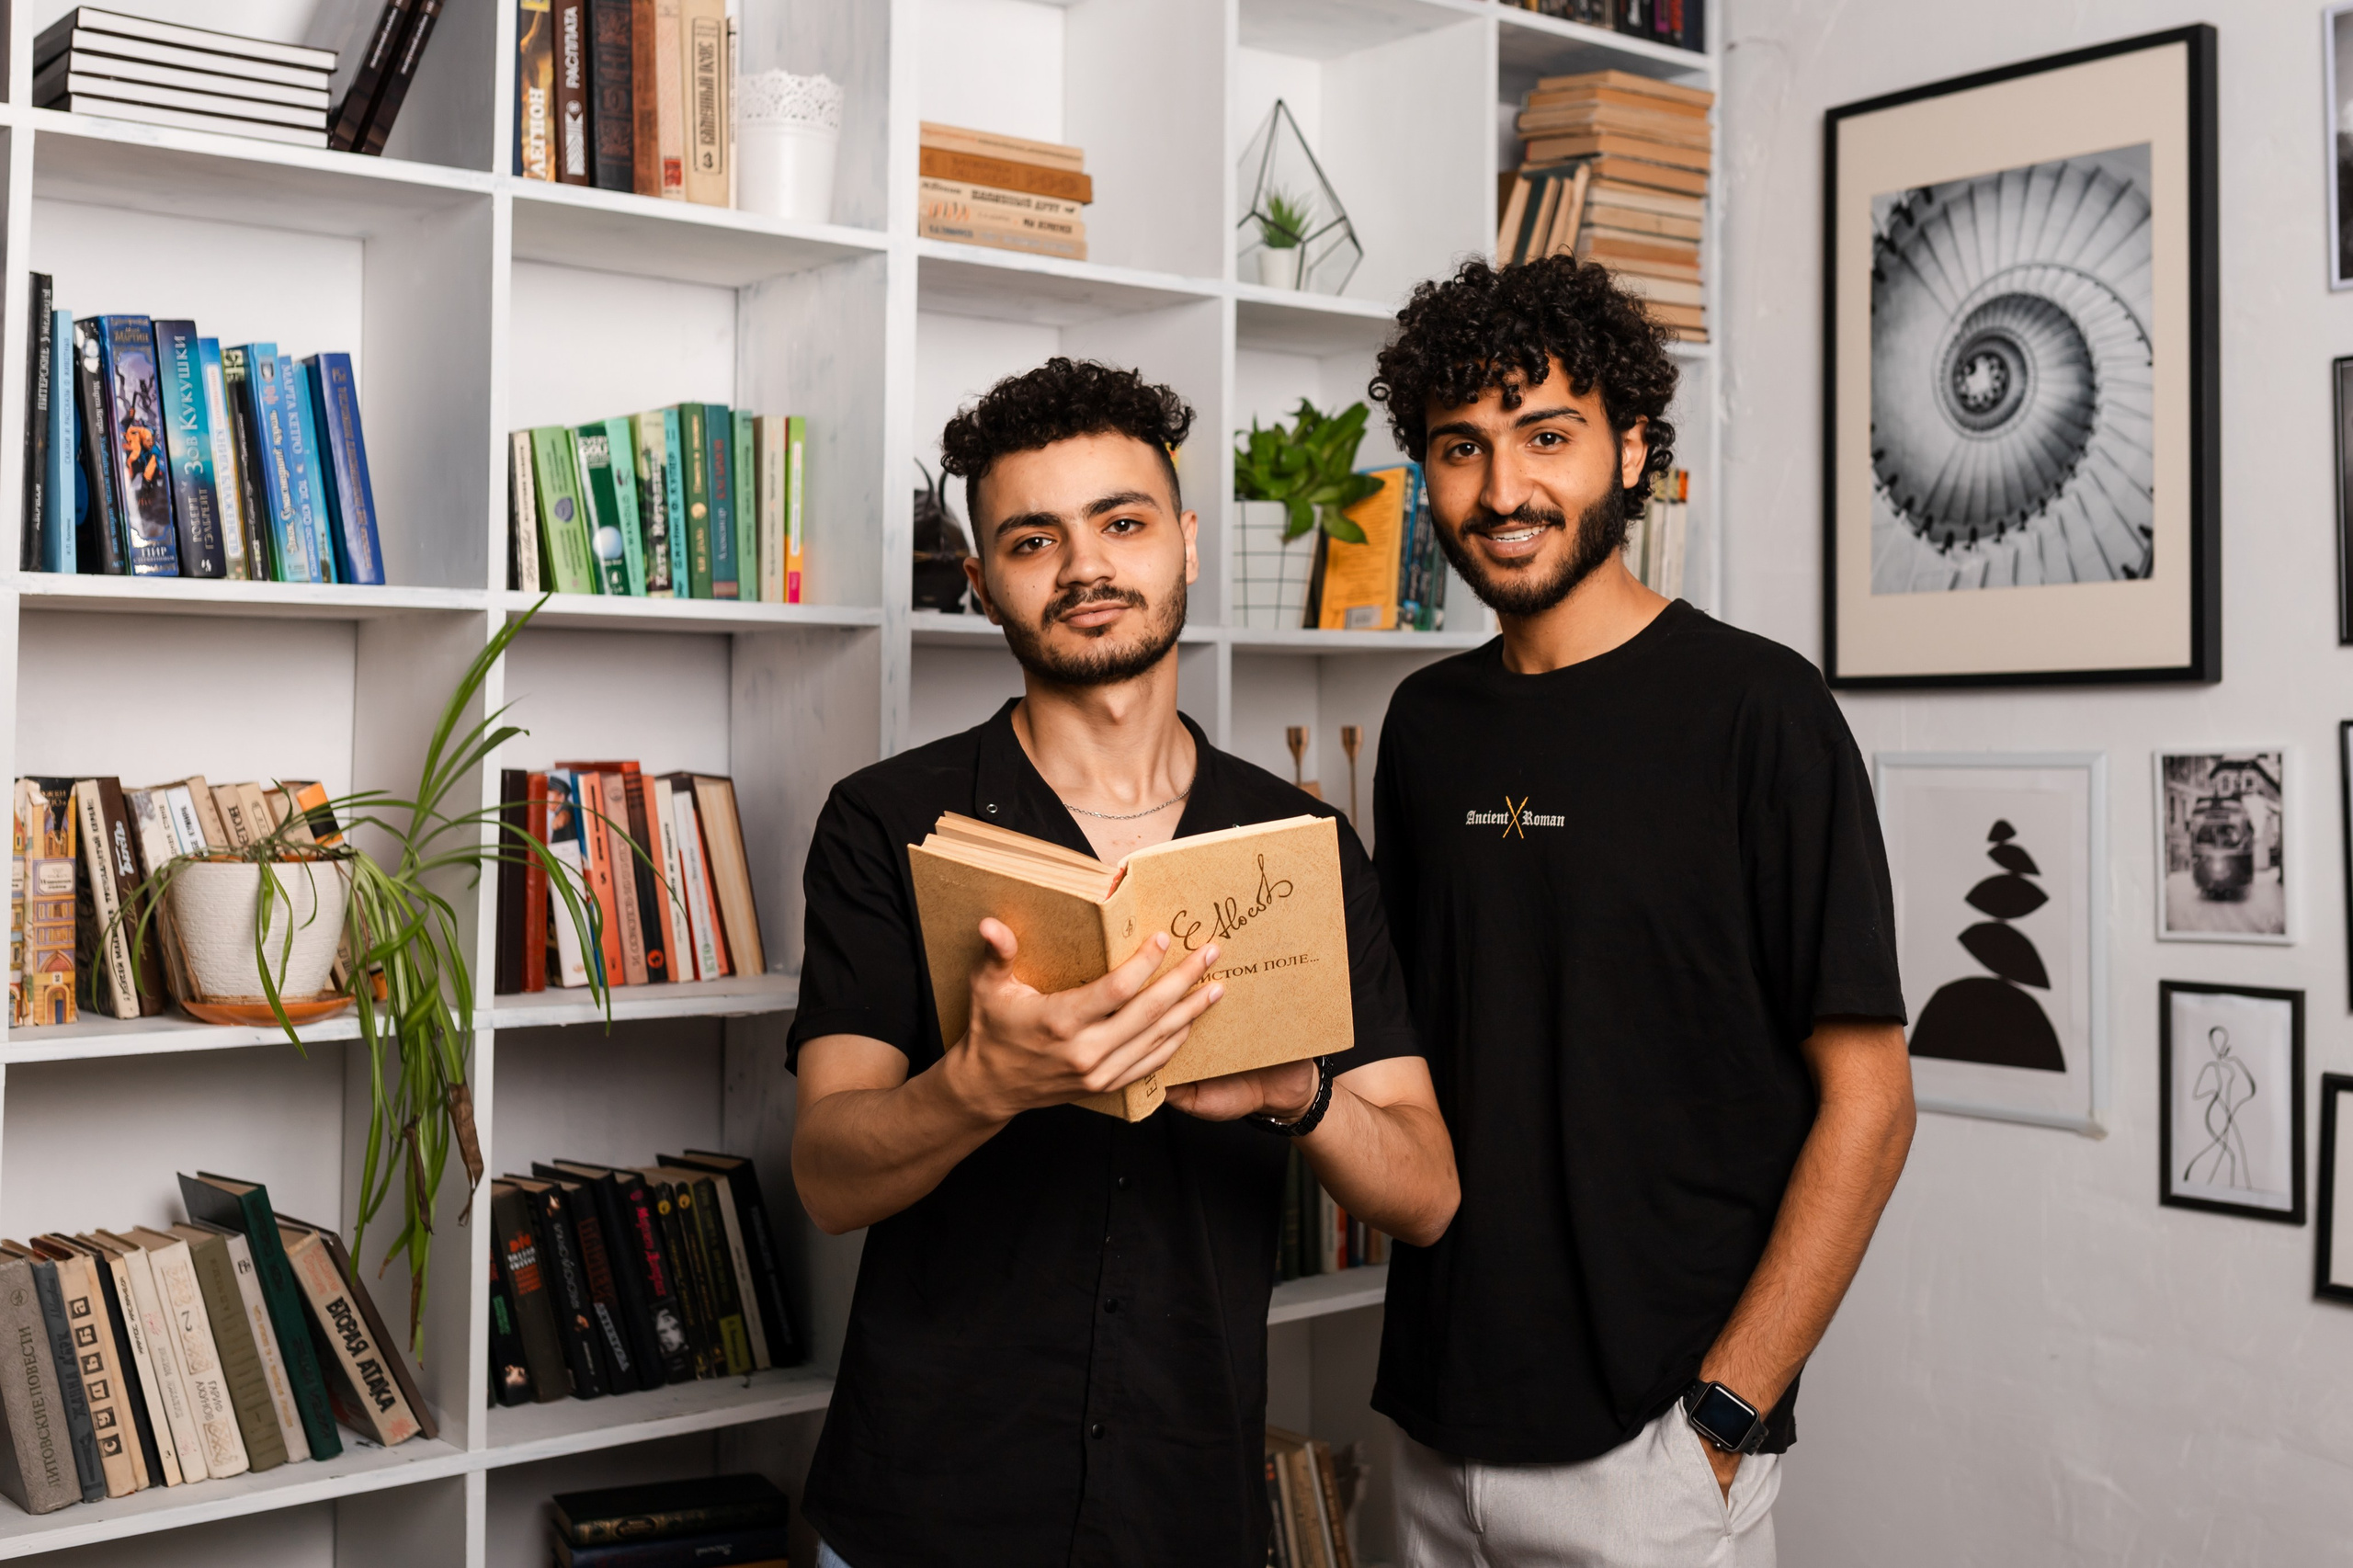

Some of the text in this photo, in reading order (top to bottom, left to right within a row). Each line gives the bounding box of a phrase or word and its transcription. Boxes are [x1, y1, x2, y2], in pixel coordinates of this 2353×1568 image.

[563, 6, 579, 89] РАСПЛАТА
[529, 86, 547, 177] ЛЕГИОН
[178, 335, 204, 474] Зов Кукушки
[281, 364, 302, 454] МАРТА КЕТРО
[215, 428, 230, 472] КНИГА
[142, 546, 167, 557] ПИР
[188, 495, 202, 542] РОБЕРТ
[198, 487, 215, 550] ГЭЛБРЕЙТ
[651, 451, 668, 586] Катя Метелица
[1465, 810, 1565, 827] Ancient Roman
[1196, 964, 1257, 984] ИСТОМ
[58, 1330, 86, 1420] ЖАННА Д'АРК
[325, 1296, 396, 1415] ВТОРАЯ АТАКА
[17, 1325, 61, 1489] ЛИТОВСКИЕ ПОВЕСТИ
[195, 1381, 213, 1422] АХУНОВ
[208, 1381, 222, 1413] ГАРИФ
